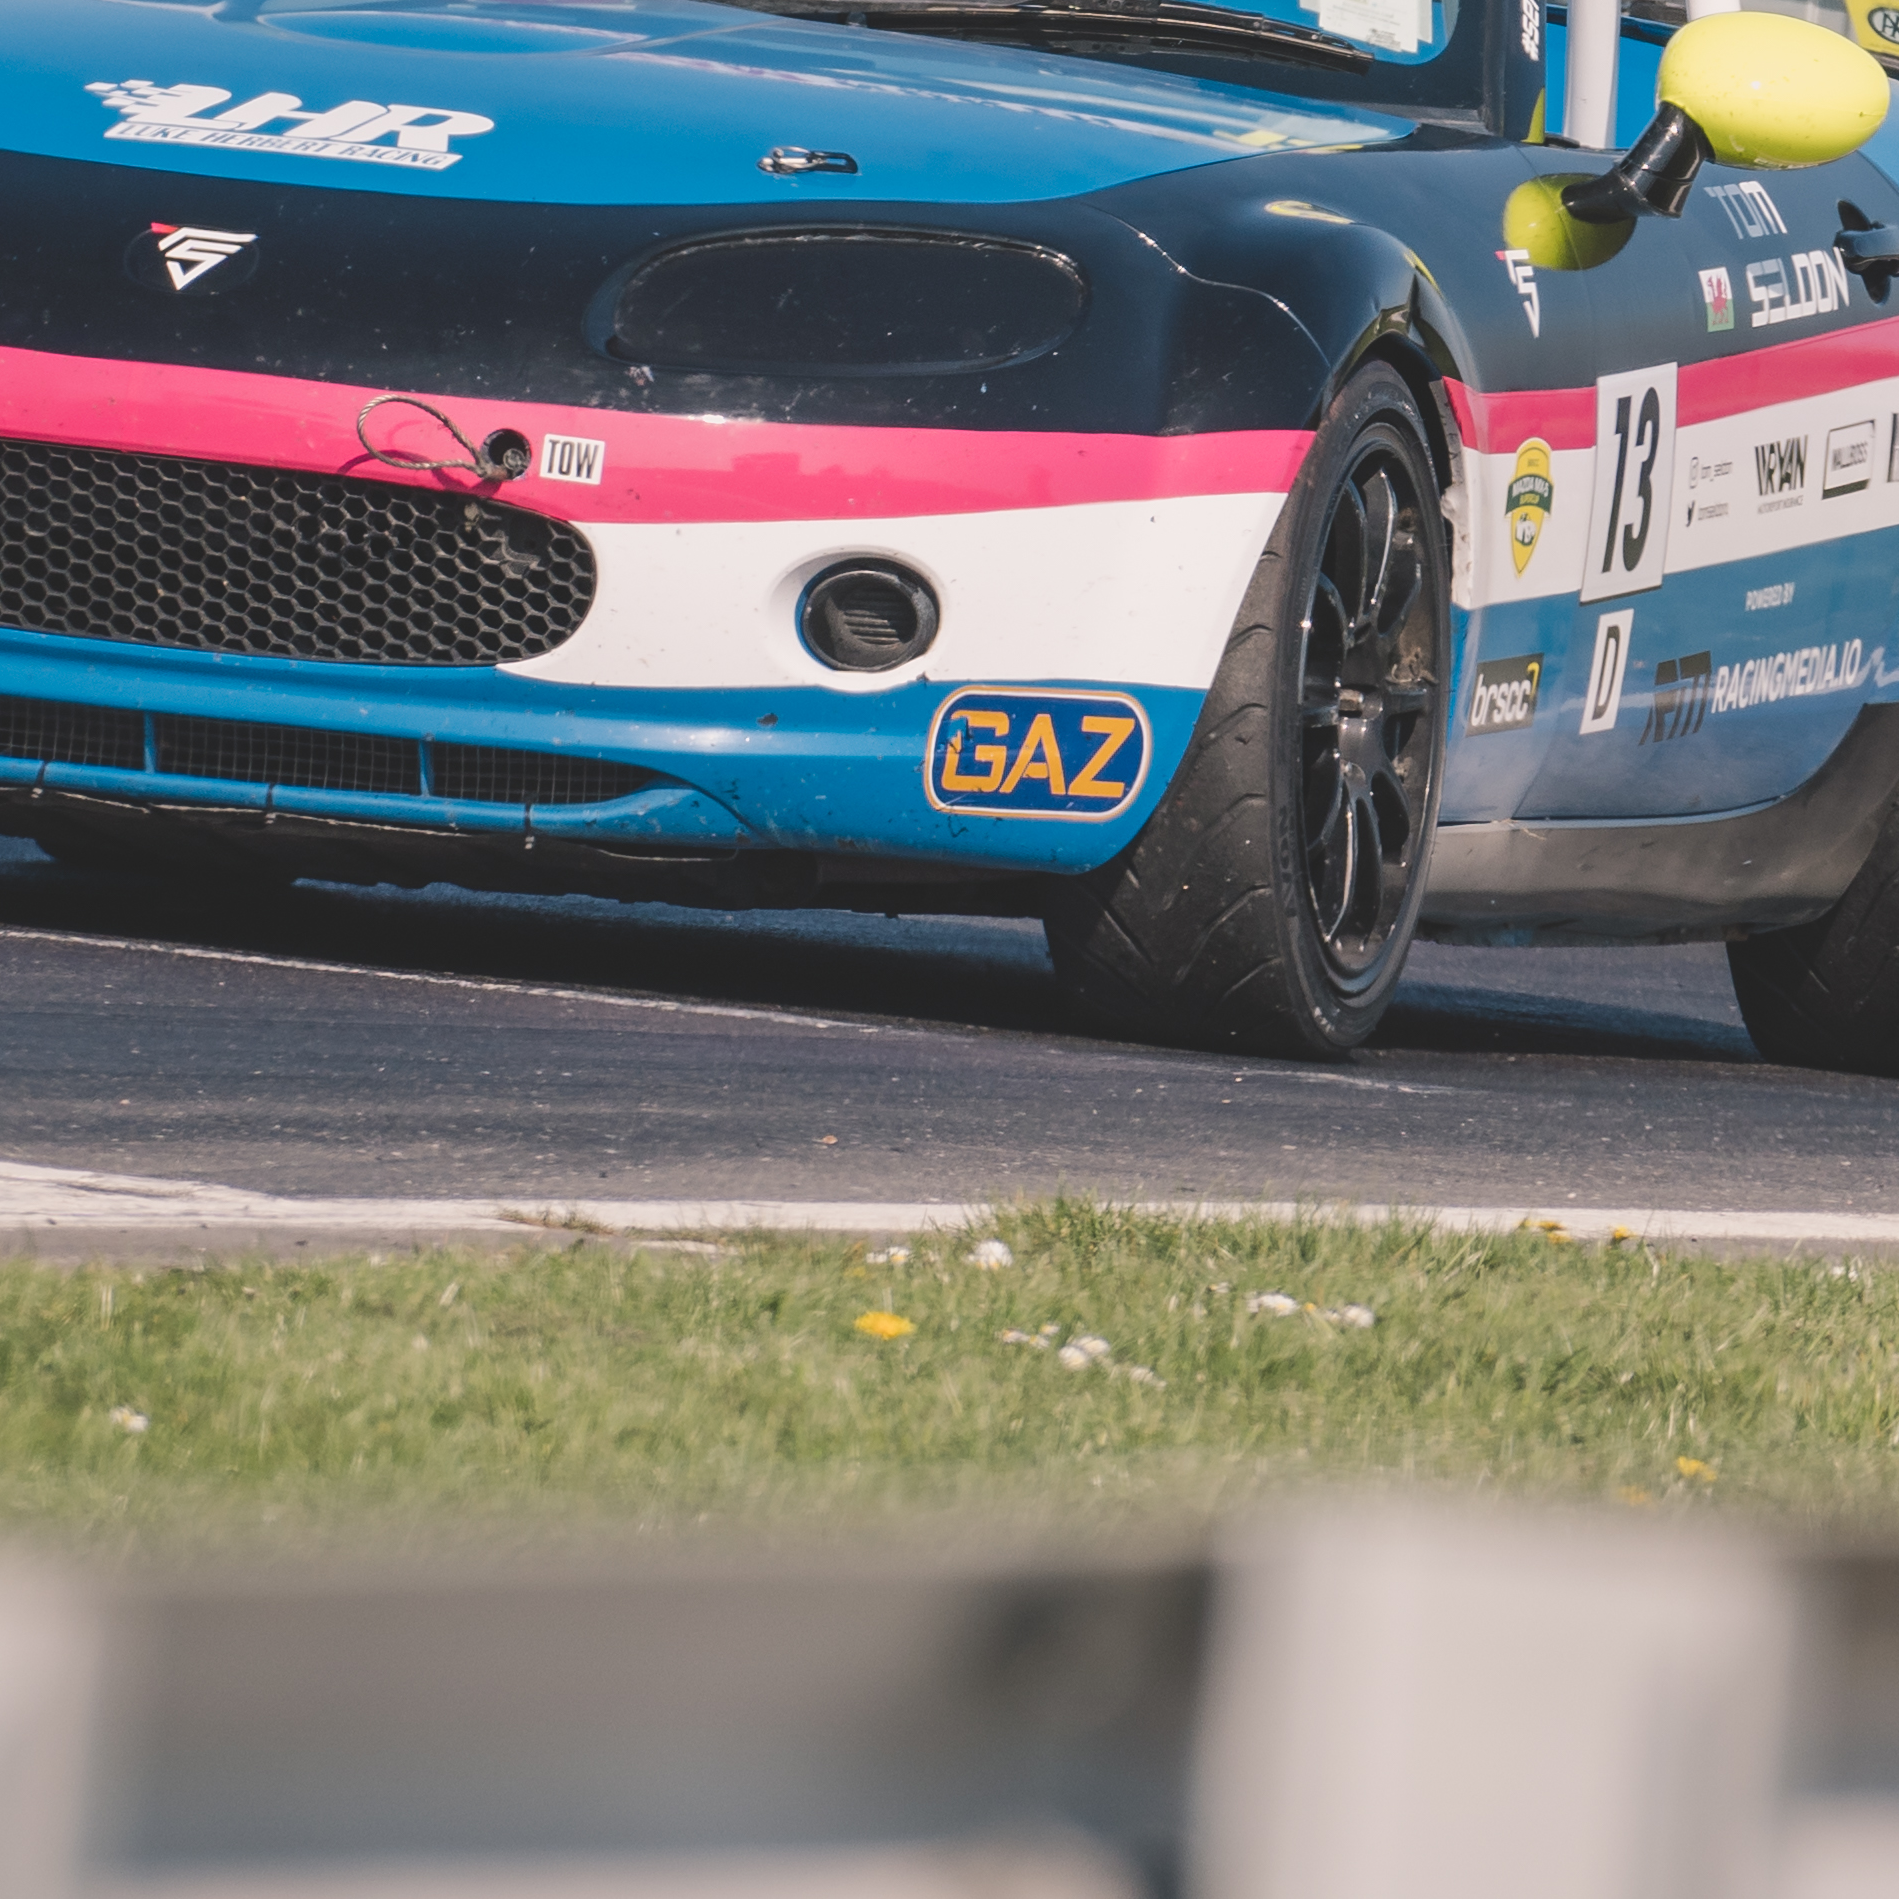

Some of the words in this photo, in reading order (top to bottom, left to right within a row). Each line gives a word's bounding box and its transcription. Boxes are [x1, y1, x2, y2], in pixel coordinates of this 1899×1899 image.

[117, 122, 197, 141] LUKE
[201, 130, 331, 153] HERBERT
[338, 143, 449, 167] RACING
[1704, 180, 1788, 240] TOM
[1746, 247, 1850, 329] SELDON
[547, 438, 600, 481] TOW
[1600, 385, 1661, 575] 13
[1470, 664, 1532, 728] brscc
[1595, 623, 1623, 723] D
[1711, 638, 1863, 714] RACINGMEDIA.IO
[940, 708, 1137, 799] GAZ
